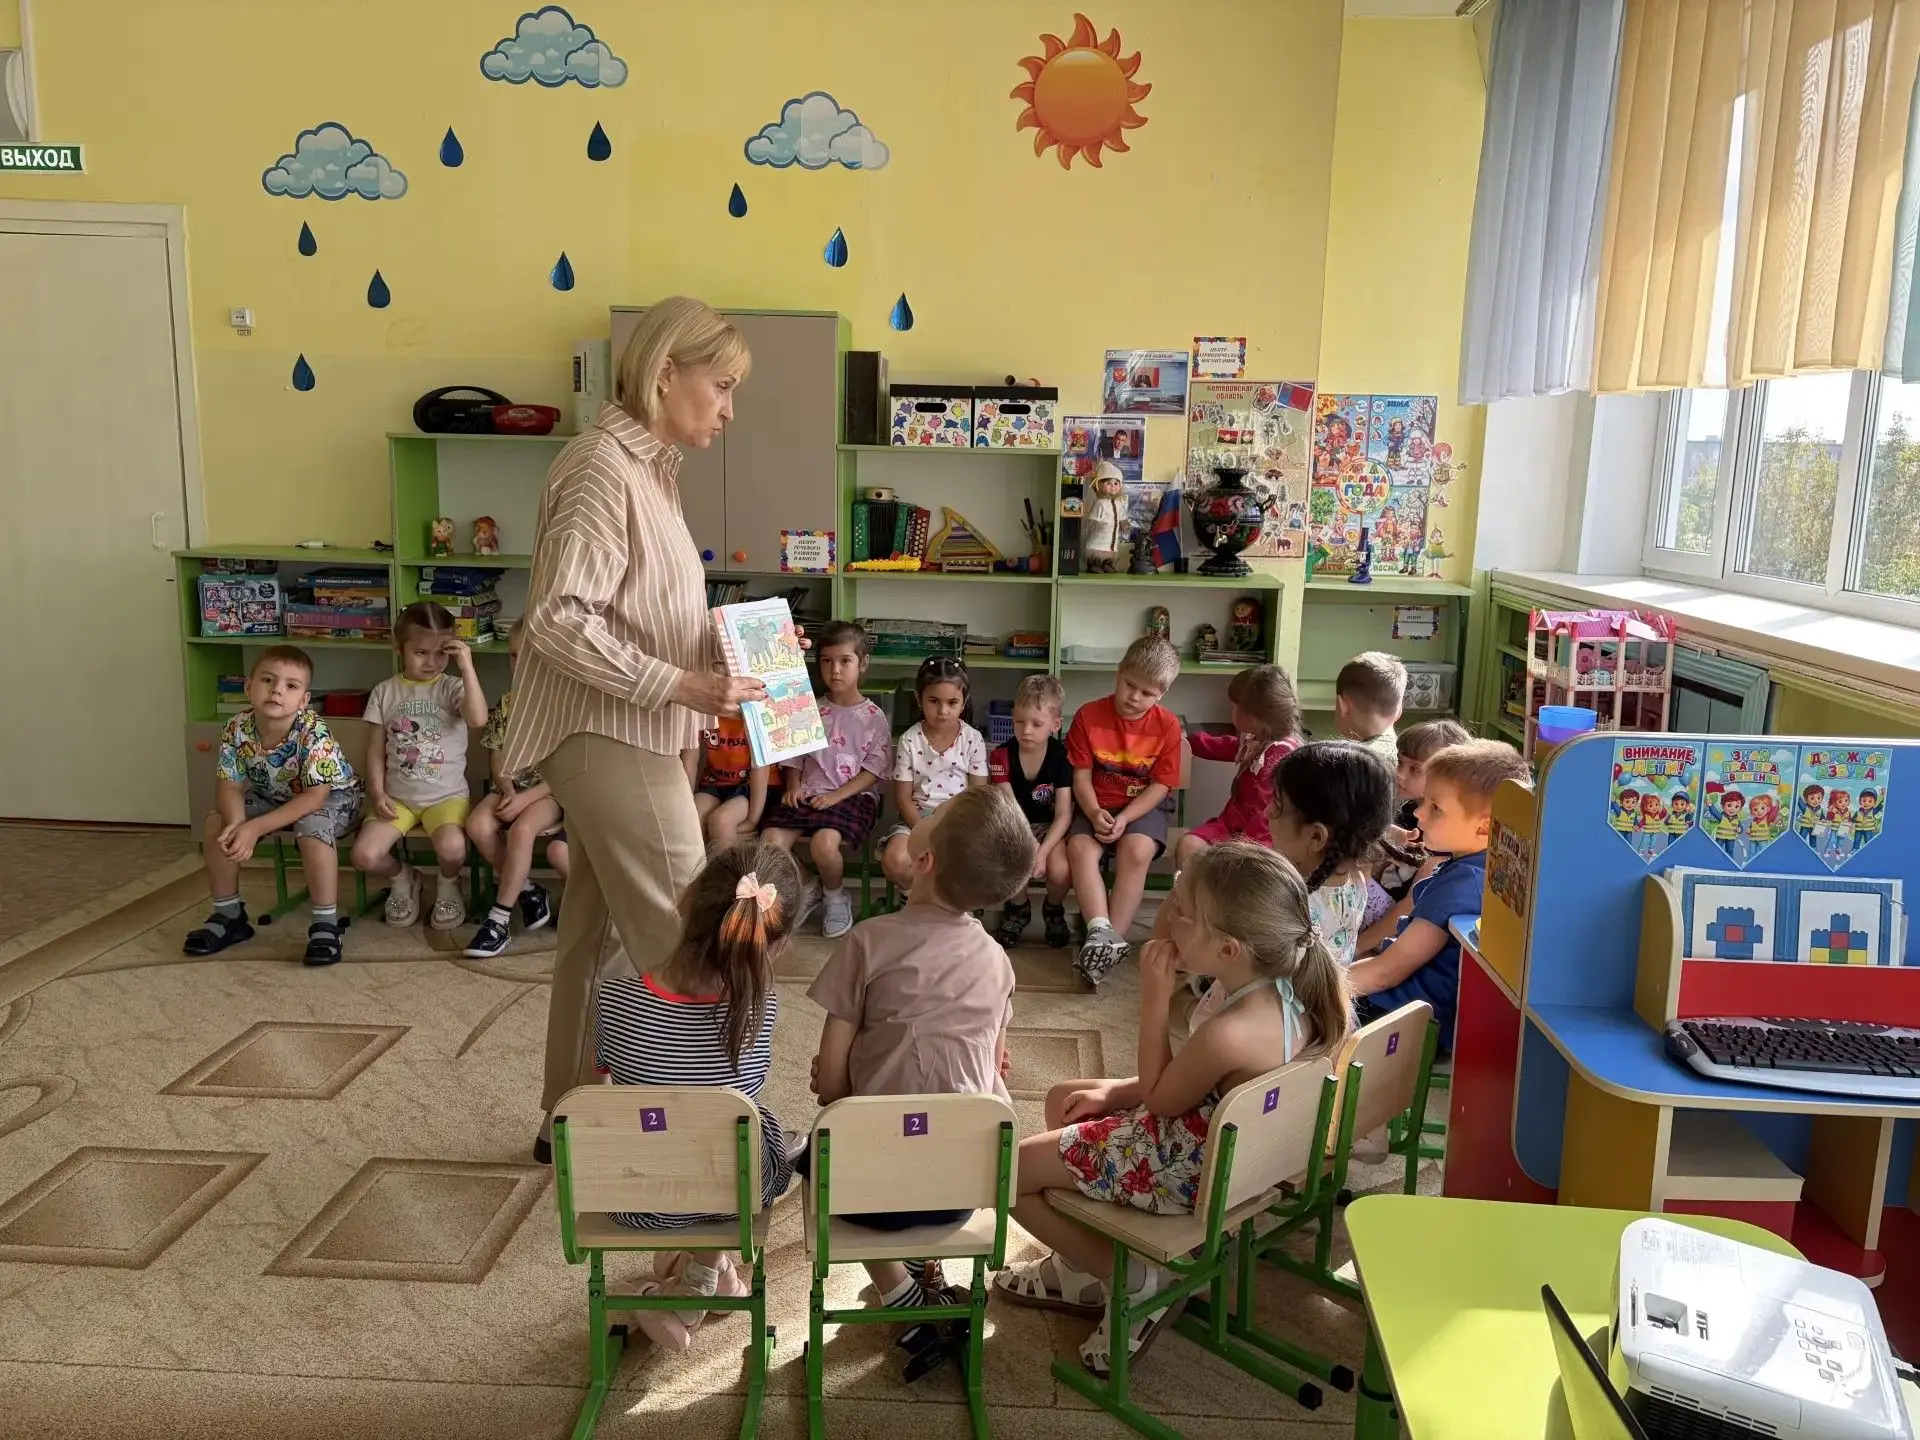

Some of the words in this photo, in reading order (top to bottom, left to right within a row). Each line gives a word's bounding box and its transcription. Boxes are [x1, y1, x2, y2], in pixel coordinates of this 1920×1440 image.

[1, 148, 75, 168] ВЫХОД
[1207, 384, 1254, 392] Кемеровская
[1216, 392, 1244, 400] область
[1386, 399, 1410, 408] ЗИМА
[1343, 483, 1386, 497] ГОДА
[1374, 564, 1400, 572] ВЕСНА
[1624, 746, 1696, 765] ВНИМАНИЕ,
[1731, 748, 1770, 762] ЗНАЙ
[1810, 750, 1886, 767] ДОРОЖНАЯ
[1631, 759, 1686, 777] ДЕТИ!
[1722, 760, 1779, 775] ПРАВИЛА
[1816, 763, 1877, 781] АЗБУКА
[1719, 771, 1780, 785] ДВИЖЕНИЯ
[1268, 1093, 1275, 1106] 2
[648, 1112, 658, 1125] 2
[911, 1117, 920, 1131] 2
